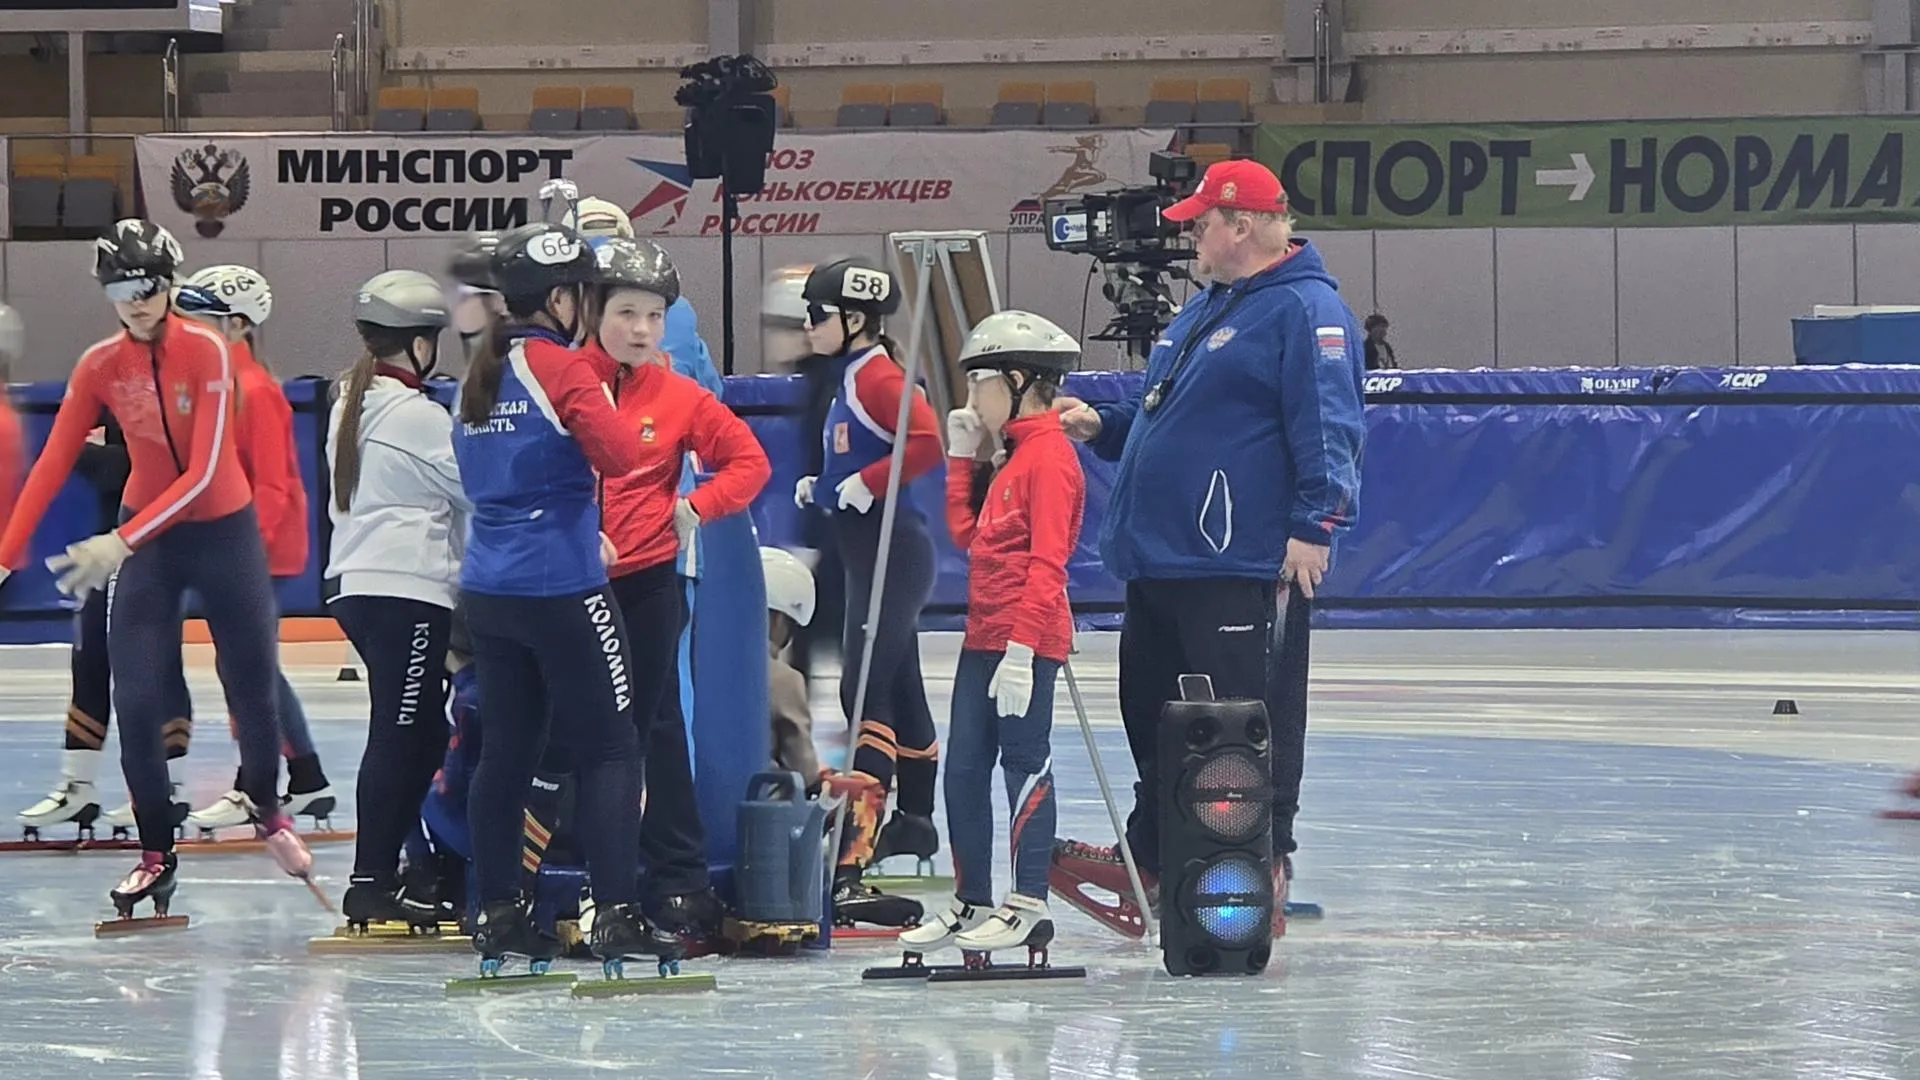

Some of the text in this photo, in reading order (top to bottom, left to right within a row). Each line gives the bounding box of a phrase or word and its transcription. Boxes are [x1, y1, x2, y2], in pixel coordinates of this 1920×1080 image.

[278, 149, 573, 183] МИНСПОРТ
[767, 149, 815, 170] ЮЗ
[1281, 132, 1903, 216] СПОРТ НОРМА
[712, 179, 952, 203] НЬКОБЕЖЦЕВ
[320, 197, 527, 232] РОССИИ
[1009, 212, 1045, 225] УПРА
[541, 237, 572, 257] 66
[220, 275, 251, 297] 66
[850, 273, 884, 297] 58
[1595, 378, 1640, 389] OLYMP
[584, 593, 631, 712] КОЛОМНА
[396, 622, 430, 726] КОЛОМНА
